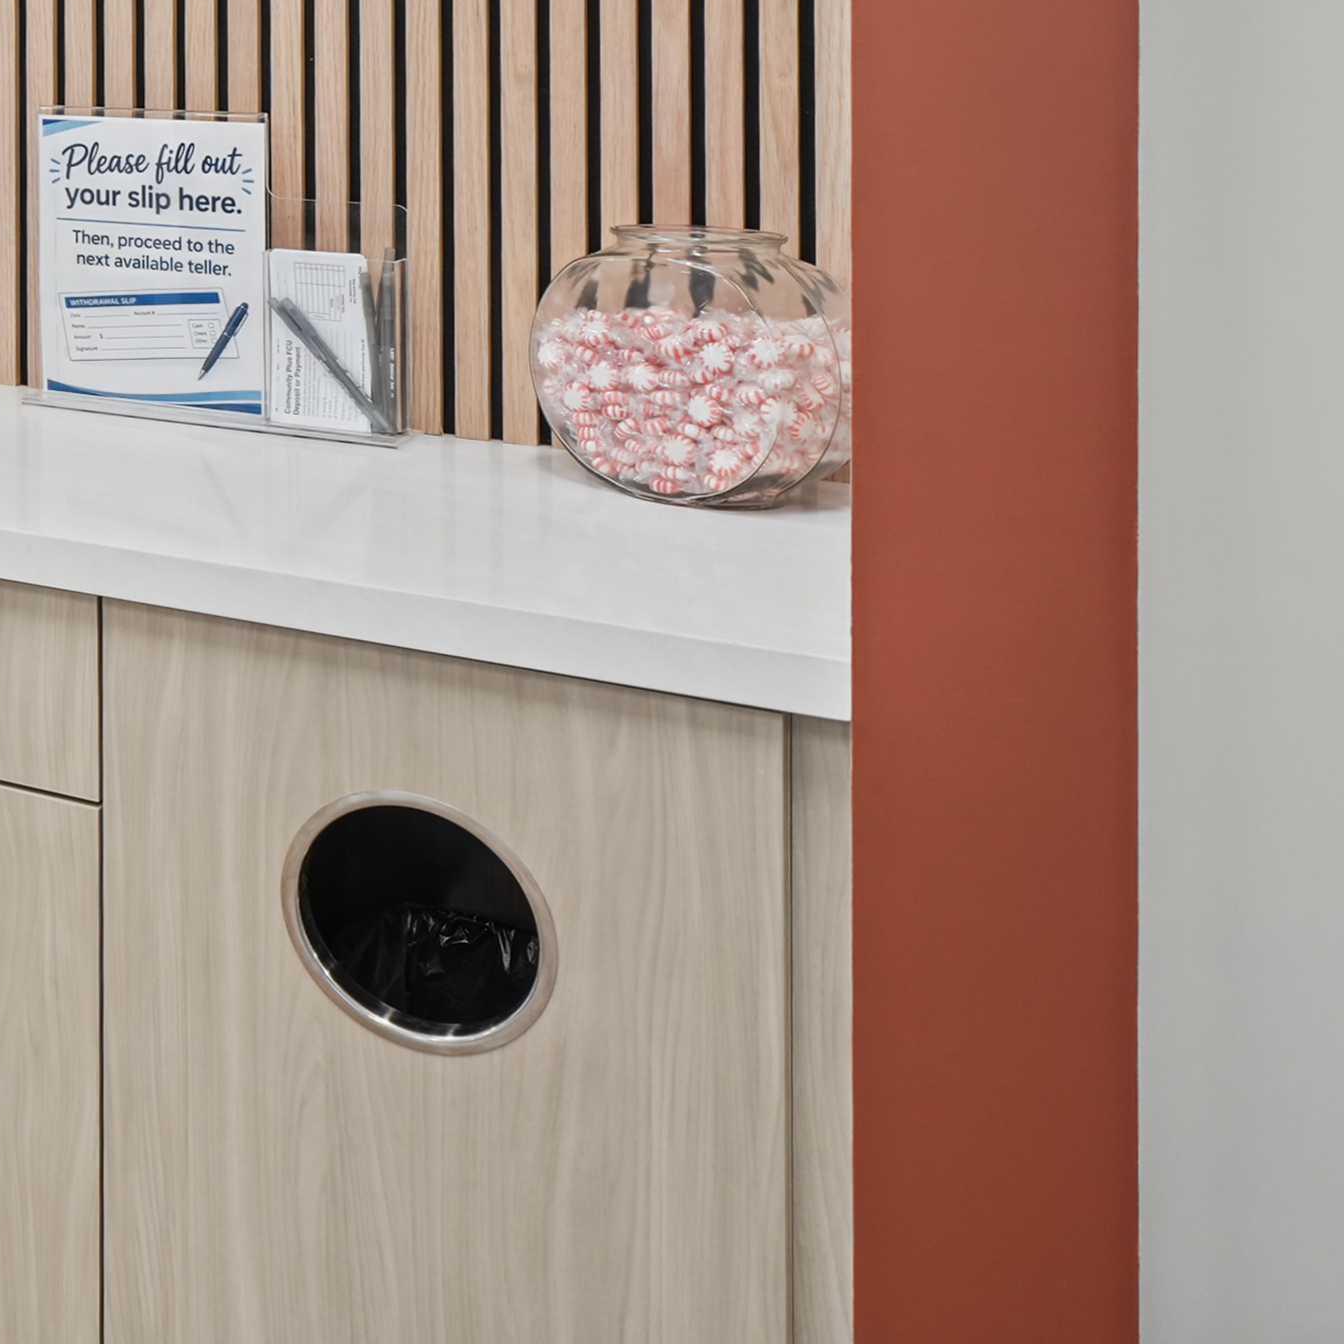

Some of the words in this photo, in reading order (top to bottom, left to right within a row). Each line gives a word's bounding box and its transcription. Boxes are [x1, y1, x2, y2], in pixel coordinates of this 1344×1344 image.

[61, 141, 150, 180] Please
[155, 142, 195, 184] fill
[201, 147, 243, 175] out
[65, 186, 121, 209] your
[127, 185, 171, 215] slip
[178, 186, 243, 215] here.
[72, 229, 114, 248] Then,
[117, 234, 182, 251] proceed
[187, 239, 203, 252] to
[207, 239, 235, 255] the
[76, 252, 110, 267] next
[114, 255, 183, 272] available
[188, 260, 232, 277] teller.
[120, 297, 137, 305] SLIP
[294, 346, 303, 377] Payment
[284, 374, 294, 415] Community
[293, 388, 303, 416] Deposit
